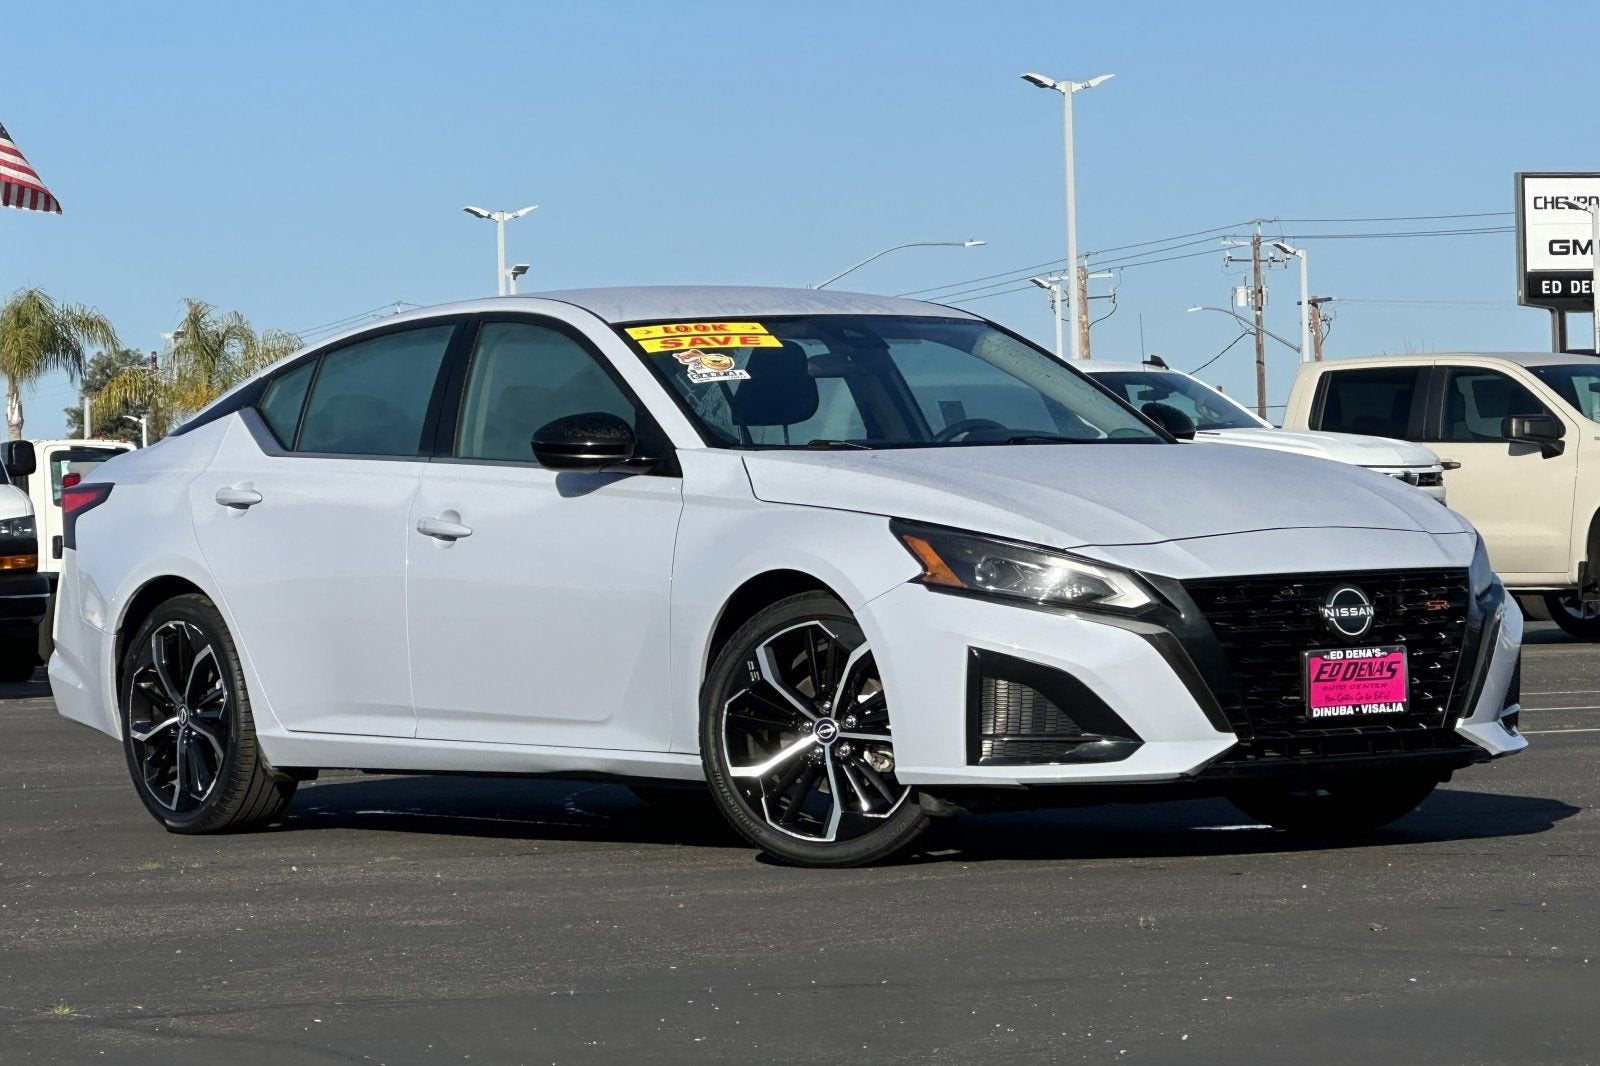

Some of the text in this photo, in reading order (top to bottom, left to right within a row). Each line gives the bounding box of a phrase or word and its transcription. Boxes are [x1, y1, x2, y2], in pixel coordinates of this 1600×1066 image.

[1548, 239, 1600, 256] GM
[1541, 280, 1594, 294] ED DE
[662, 323, 731, 334] LOOK
[659, 336, 761, 349] SAVE
[1425, 600, 1450, 611] SR
[1324, 606, 1374, 618] NISSAN
[1330, 648, 1382, 660] ED DENA'S
[1313, 660, 1401, 682] ED DENA'S
[1349, 682, 1388, 690] CENTER
[1313, 702, 1404, 718] DINUBA VISALIA
